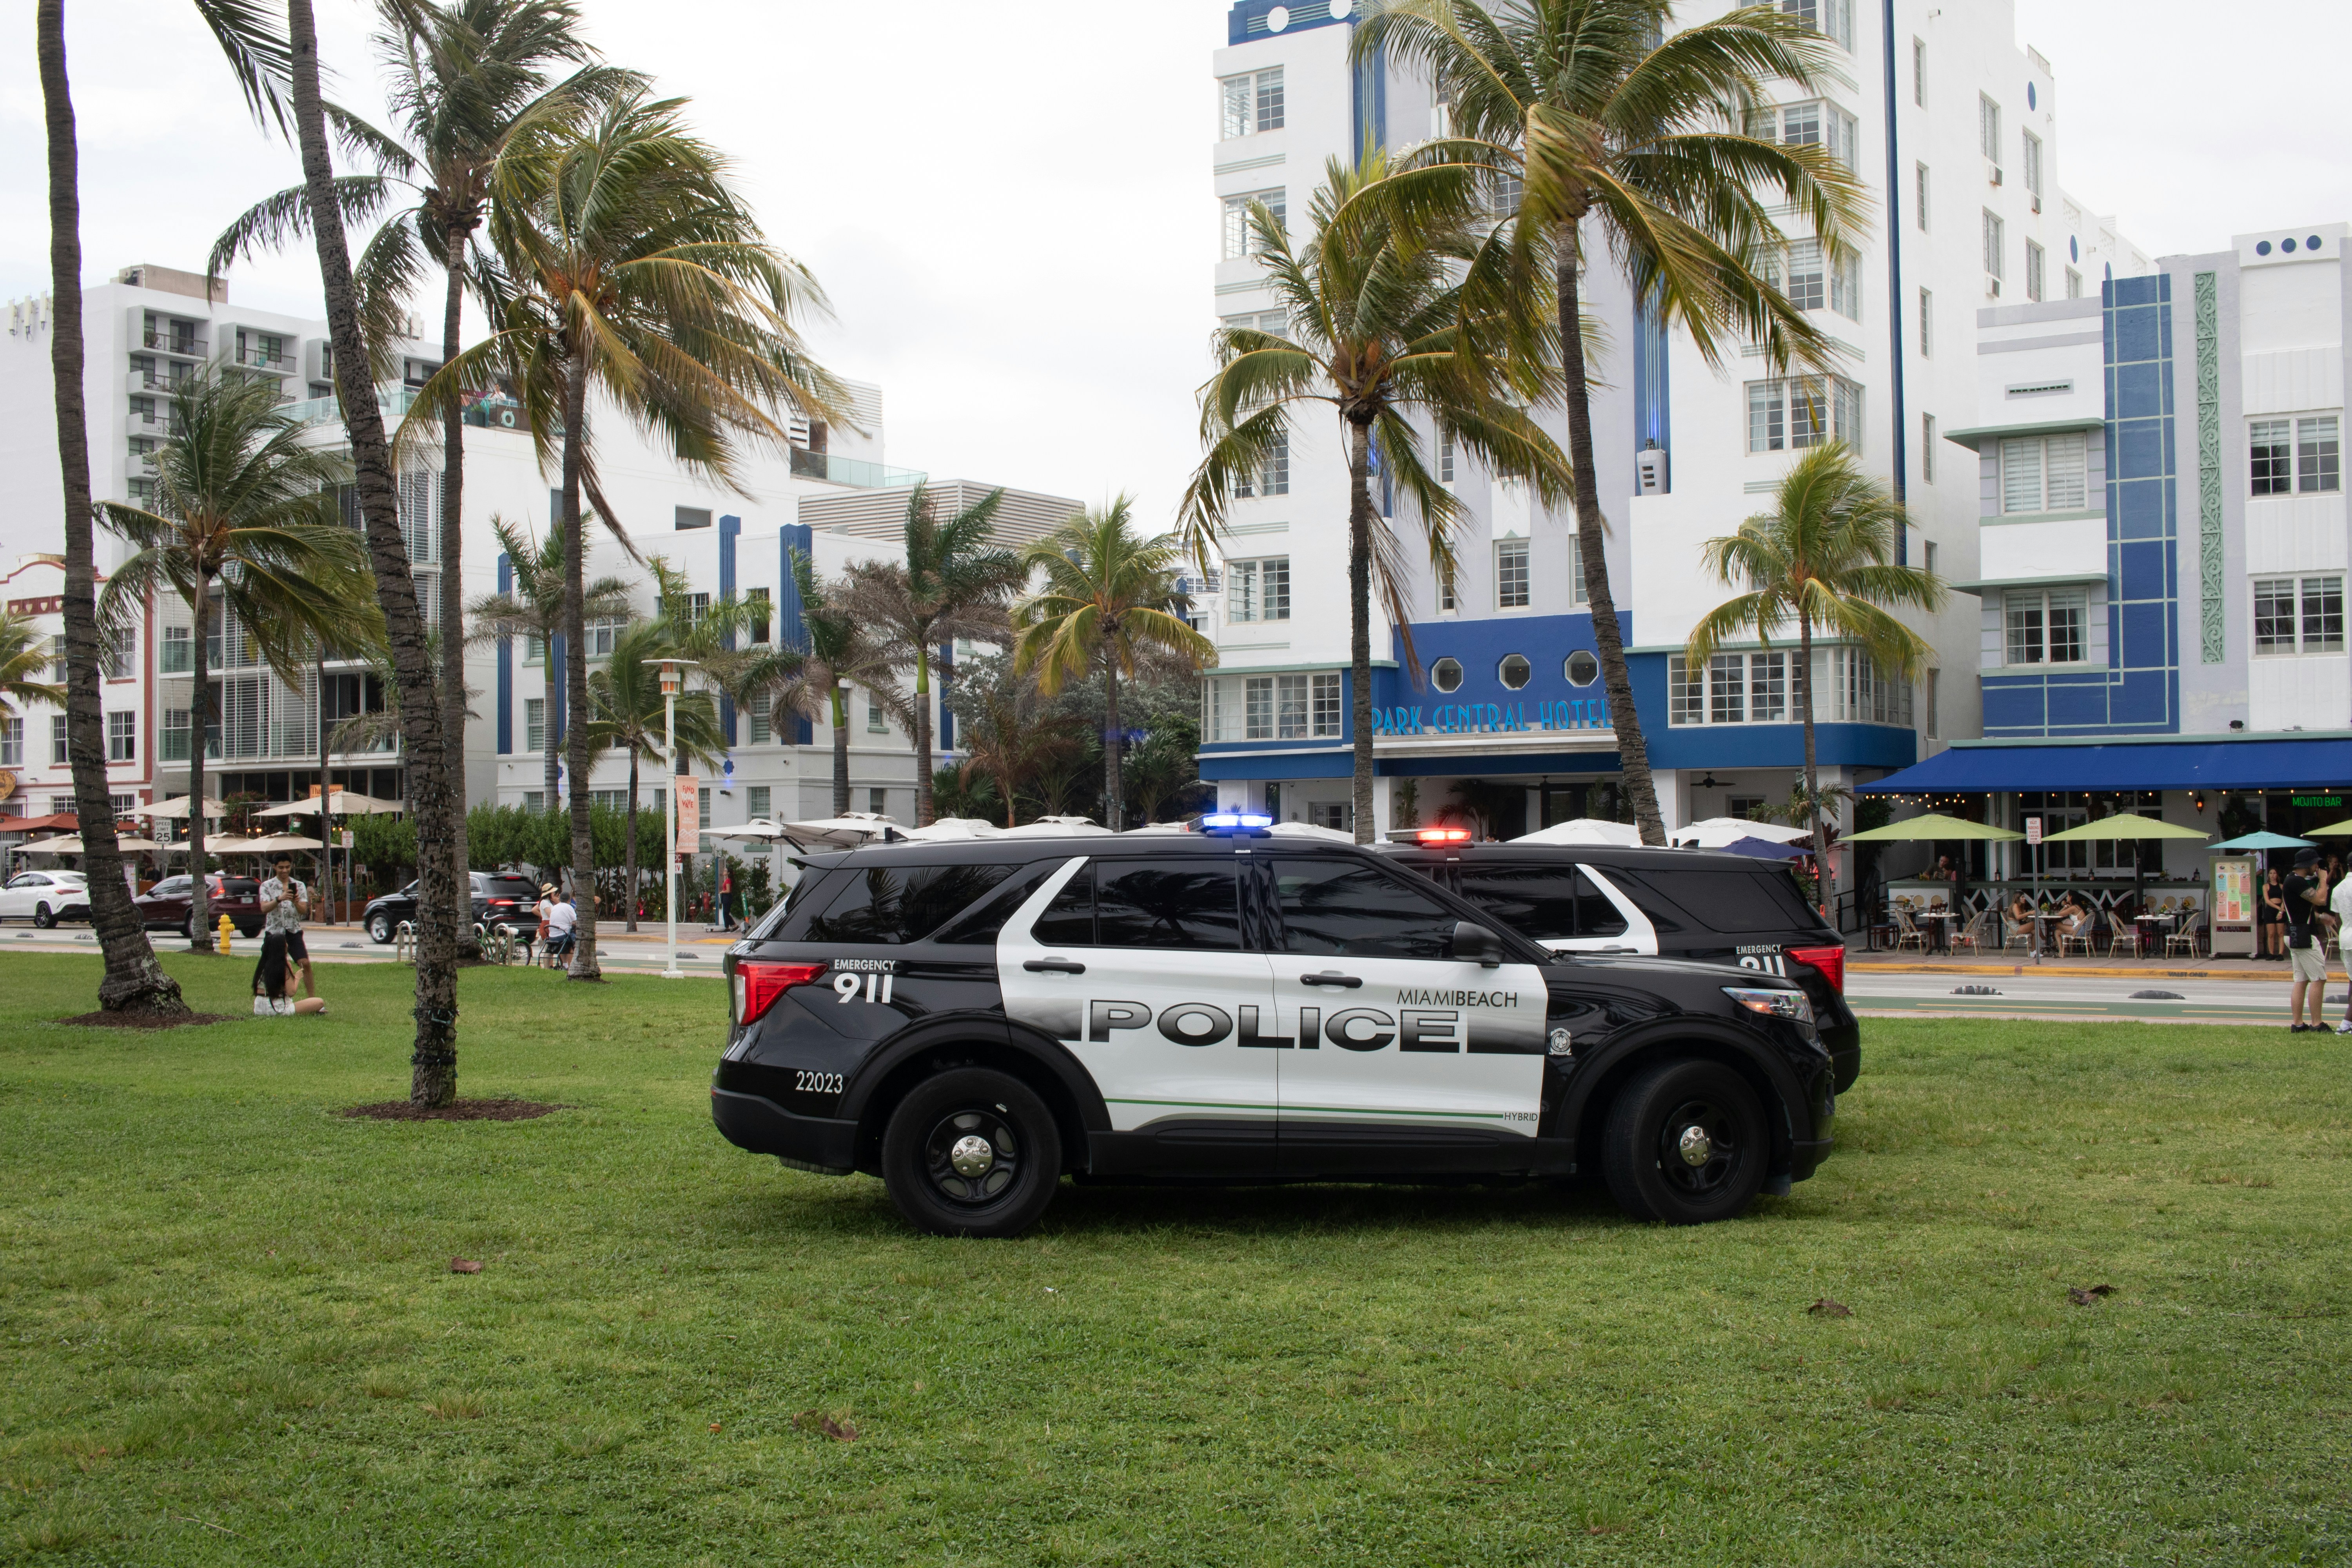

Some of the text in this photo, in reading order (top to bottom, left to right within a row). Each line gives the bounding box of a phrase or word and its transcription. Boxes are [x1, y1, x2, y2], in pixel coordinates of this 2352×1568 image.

[1372, 699, 1613, 736] PARK CENTRAL HOTEL
[682, 785, 694, 794] FIND
[681, 792, 694, 801] YOUR
[682, 800, 693, 808] WAVE
[2293, 797, 2341, 806] MOJITO BAR
[156, 833, 170, 842] 25
[1736, 944, 1781, 954] EMERGENCY
[834, 959, 896, 971] EMERGENCY
[834, 973, 893, 1003] 911
[1089, 999, 1460, 1053] POLICE
[795, 1071, 842, 1094] 22023
[1504, 1112, 1537, 1121] HYBRID
